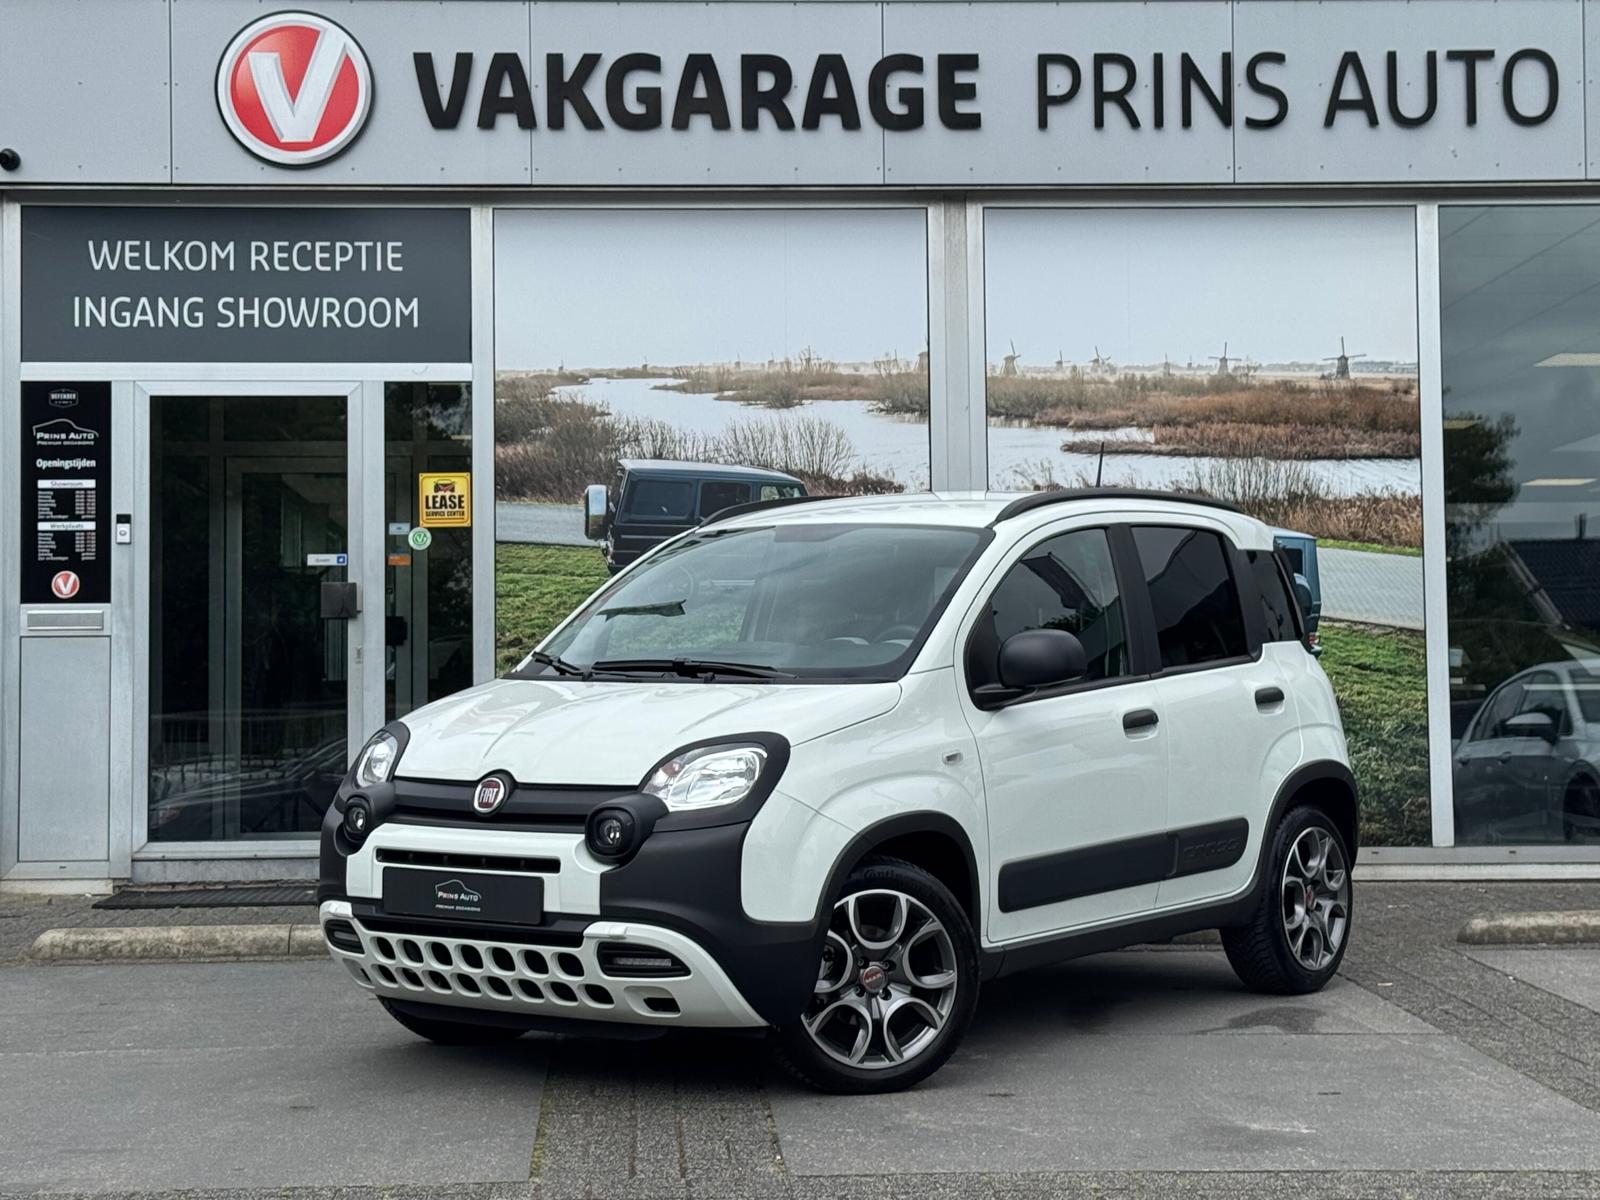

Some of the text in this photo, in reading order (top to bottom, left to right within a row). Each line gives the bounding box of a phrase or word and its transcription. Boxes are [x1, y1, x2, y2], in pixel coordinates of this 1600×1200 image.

[248, 28, 346, 144] V
[413, 48, 1559, 132] VAKGARAGE PRINS AUTO
[88, 240, 403, 272] WELKOM RECEPTIE
[74, 296, 419, 328] INGANG SHOWROOM
[68, 432, 95, 440] AUTO
[36, 458, 96, 470] Openingstijden
[425, 494, 465, 510] LEASE
[480, 787, 498, 803] FIAT
[459, 893, 479, 902] AUTO
